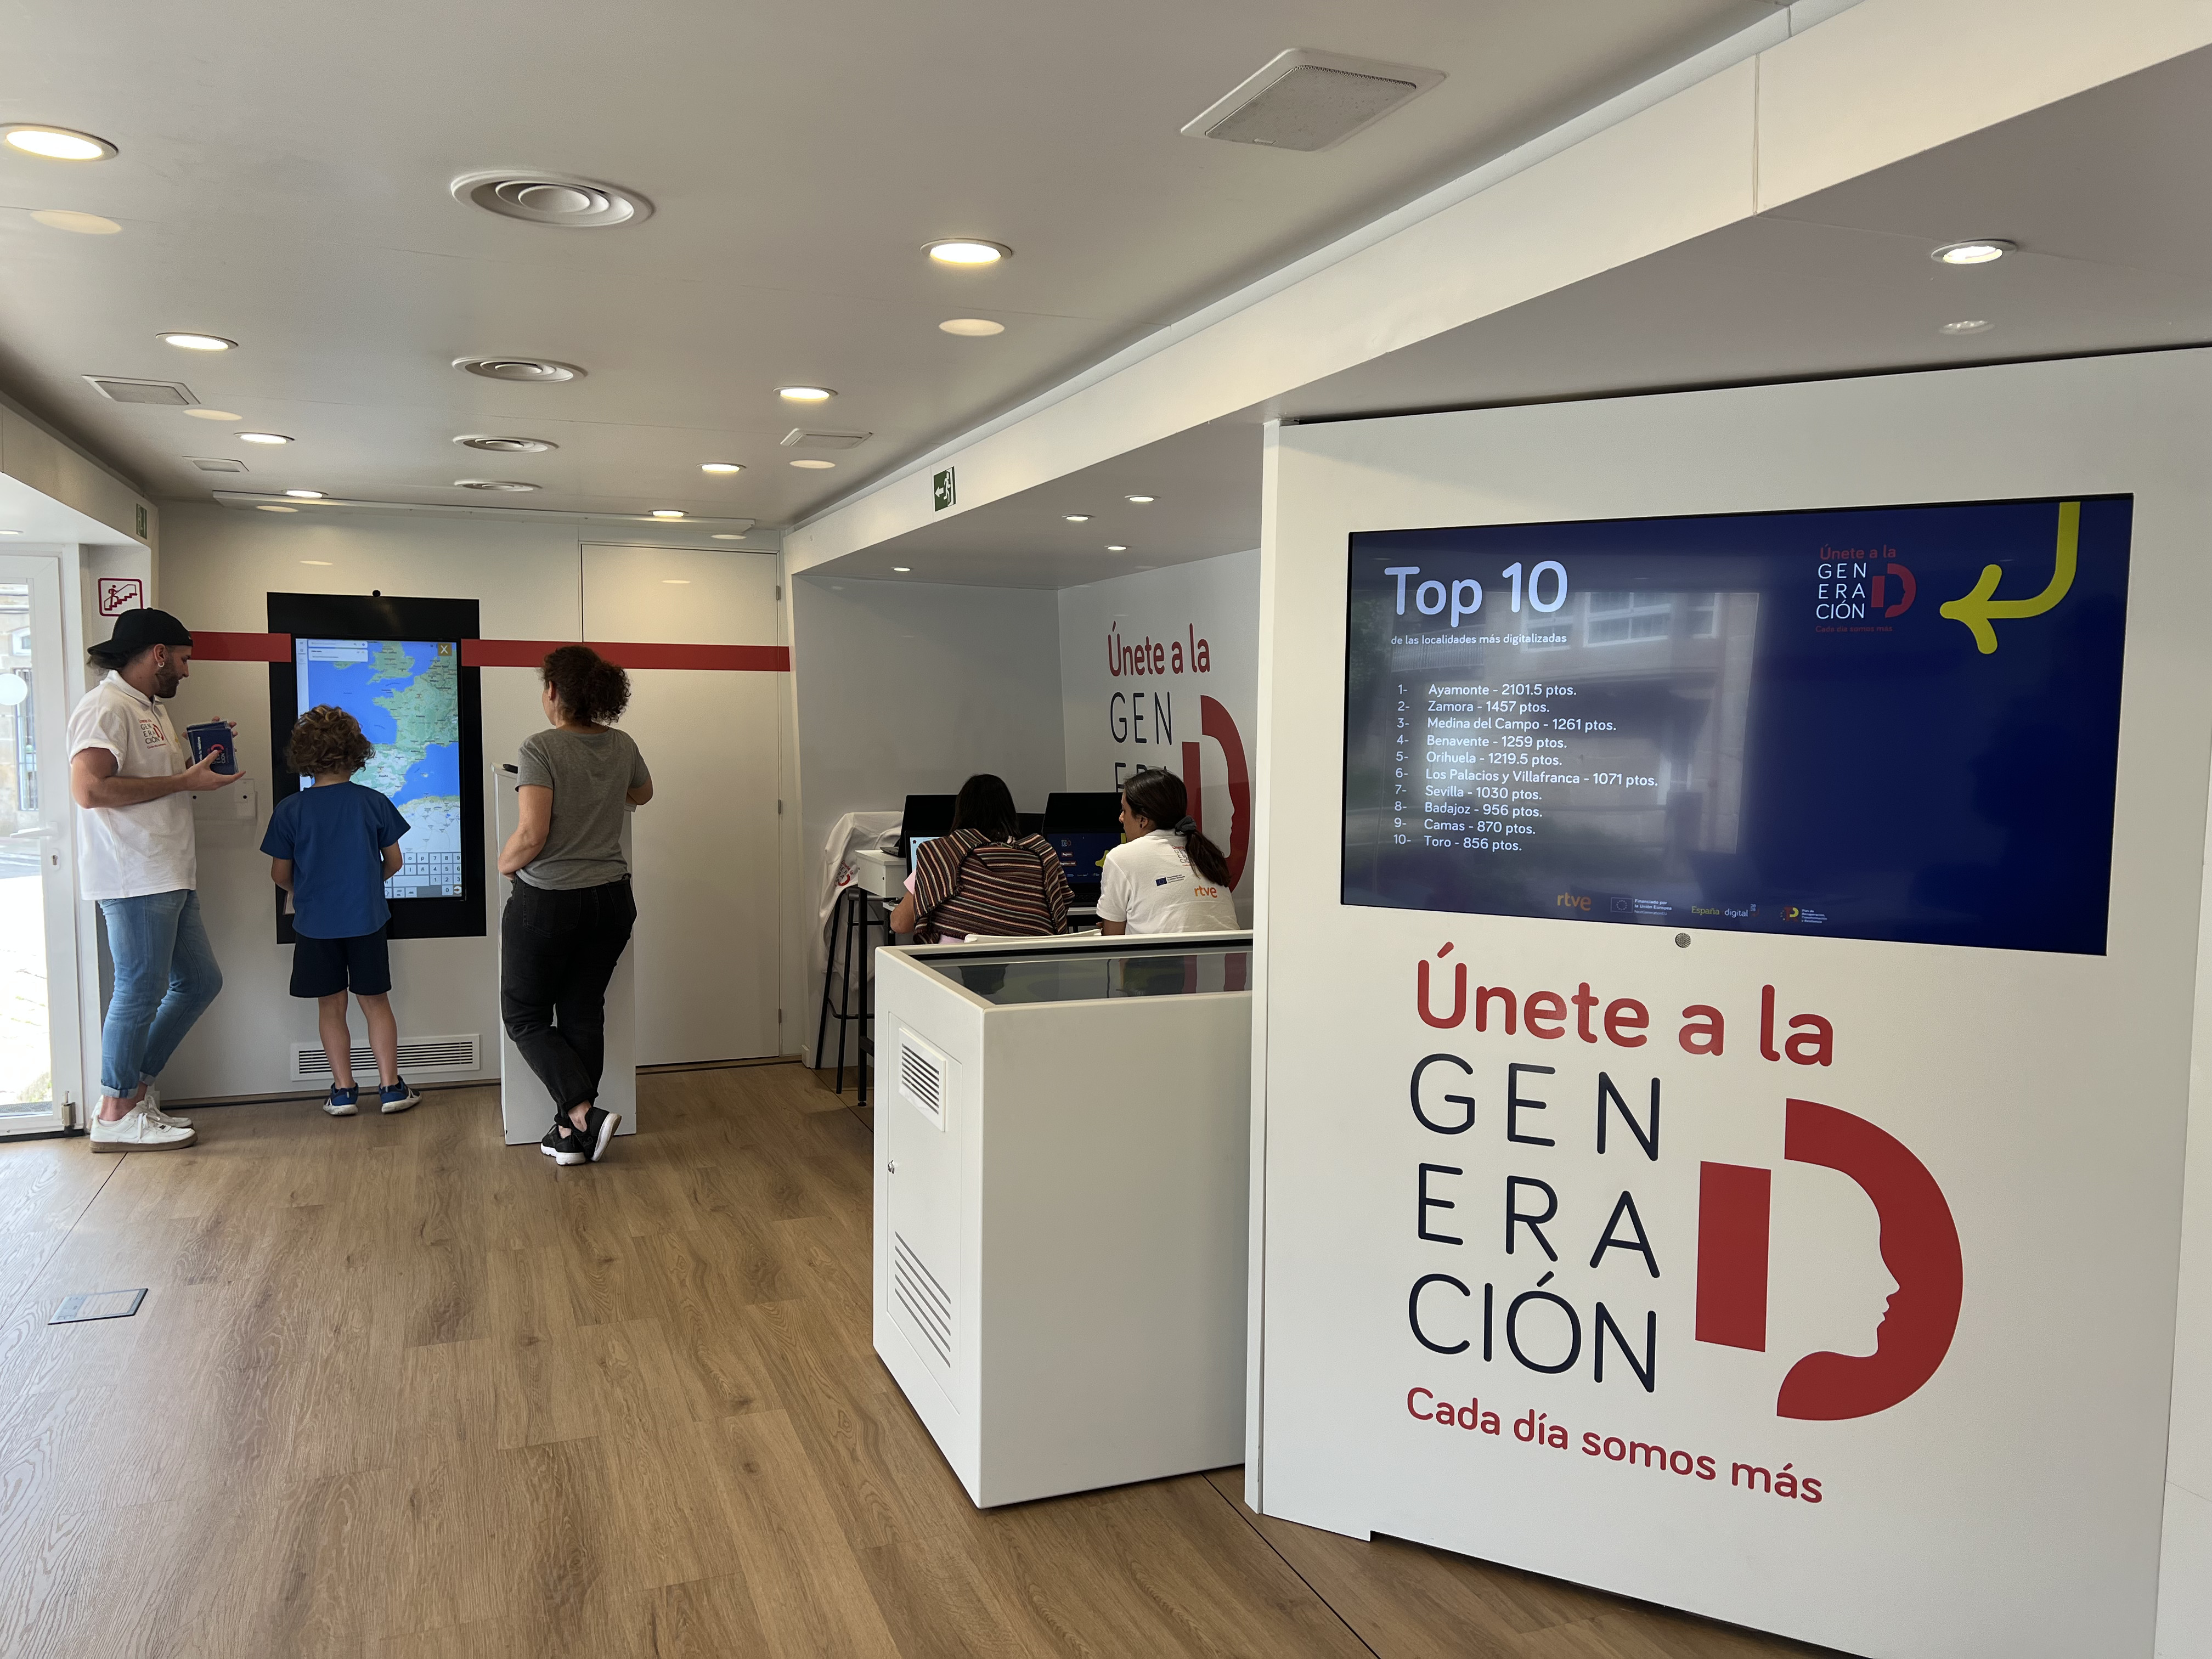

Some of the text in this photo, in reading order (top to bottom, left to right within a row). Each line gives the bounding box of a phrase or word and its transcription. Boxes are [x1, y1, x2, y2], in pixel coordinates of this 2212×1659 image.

[1870, 549, 1877, 558] a
[1883, 544, 1896, 558] la
[1818, 562, 1866, 579] GEN
[1384, 560, 1568, 628] Top 10
[1819, 583, 1865, 599] ERA
[1816, 600, 1865, 619] CIÓN
[1108, 620, 1210, 677] Únete a la
[1391, 633, 1567, 646] de las localidades más digitalizadas
[1398, 684, 1408, 694] 1-
[1429, 684, 1489, 697] Ayamonte
[1502, 684, 1542, 695] 2101.5
[1546, 685, 1577, 698] ptos.
[1398, 701, 1410, 711] 2-
[1428, 701, 1474, 712] Zamora
[1486, 701, 1517, 712] 1457
[1520, 702, 1550, 715] ptos.
[1110, 691, 1172, 746] GEN
[1397, 718, 1409, 728] 3-
[1427, 717, 1470, 729] Medina
[1474, 718, 1492, 729] del
[1495, 718, 1539, 732] Campo
[1553, 718, 1581, 730] 1261
[1585, 720, 1616, 733] ptos.
[1397, 735, 1409, 745] 4-
[1427, 735, 1489, 746] Benavente
[1502, 736, 1532, 747] 1259
[1537, 738, 1567, 751] ptos.
[1396, 751, 1409, 761] 5-
[1426, 751, 1476, 764] Orihuela
[1488, 753, 1528, 765] 1219.5
[1532, 755, 1562, 768] ptos.
[1395, 768, 1408, 778] 6-
[1426, 769, 1447, 779] Los
[1450, 769, 1499, 781] Palacios
[1502, 774, 1509, 785] y
[1513, 770, 1580, 783] Villafranca
[1593, 772, 1622, 785] 1071
[1626, 775, 1658, 788] ptos.
[1395, 785, 1407, 794] 7-
[1425, 785, 1464, 797] Sevilla
[1476, 787, 1508, 798] 1030
[1512, 789, 1542, 801] ptos.
[1395, 801, 1407, 811] 8-
[1425, 802, 1471, 816] Badajoz
[1483, 804, 1509, 816] 956
[1513, 807, 1543, 819] ptos.
[1394, 817, 1407, 828] 9-
[1424, 819, 1465, 831] Camas
[1477, 821, 1502, 833] 870
[1506, 824, 1536, 836] ptos.
[1393, 834, 1411, 844] 10-
[1424, 835, 1451, 847] Toro
[1463, 837, 1488, 849] 856
[1492, 840, 1522, 852] ptos.
[1194, 885, 1217, 898] rtve
[1557, 892, 1592, 911] rtve
[1691, 906, 1748, 918] España digital
[1417, 941, 1833, 1066] Únete a la
[1409, 1052, 1661, 1161] GEN
[1417, 1162, 1661, 1278] ERA
[1408, 1270, 1656, 1392] CIÓN
[1407, 1387, 1822, 1503] Cada día somos más
